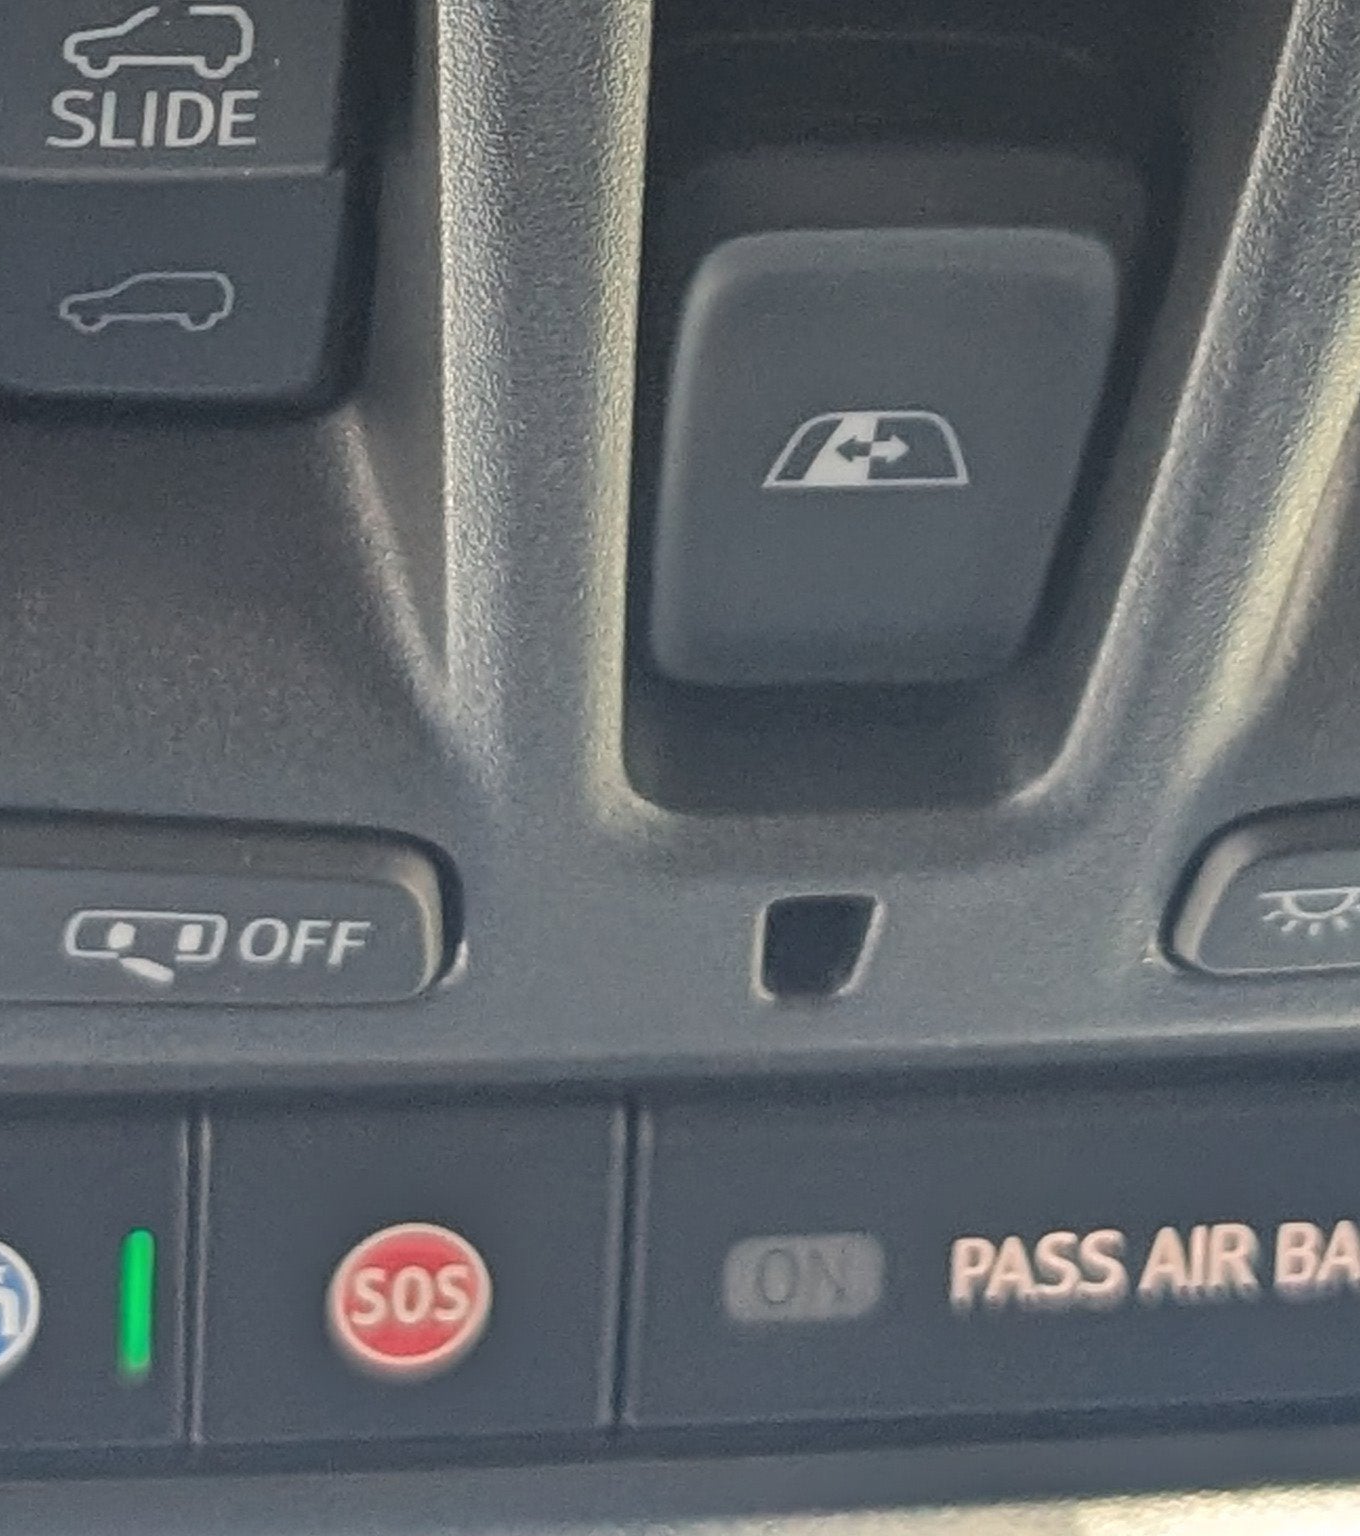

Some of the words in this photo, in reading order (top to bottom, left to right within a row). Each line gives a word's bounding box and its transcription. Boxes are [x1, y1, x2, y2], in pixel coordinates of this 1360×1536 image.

[46, 90, 259, 148] SLIDE
[240, 918, 371, 965] OFF
[351, 1264, 470, 1326] SOS
[755, 1247, 849, 1307] ON
[950, 1229, 1129, 1310] PASS
[1139, 1224, 1260, 1300] AIR
